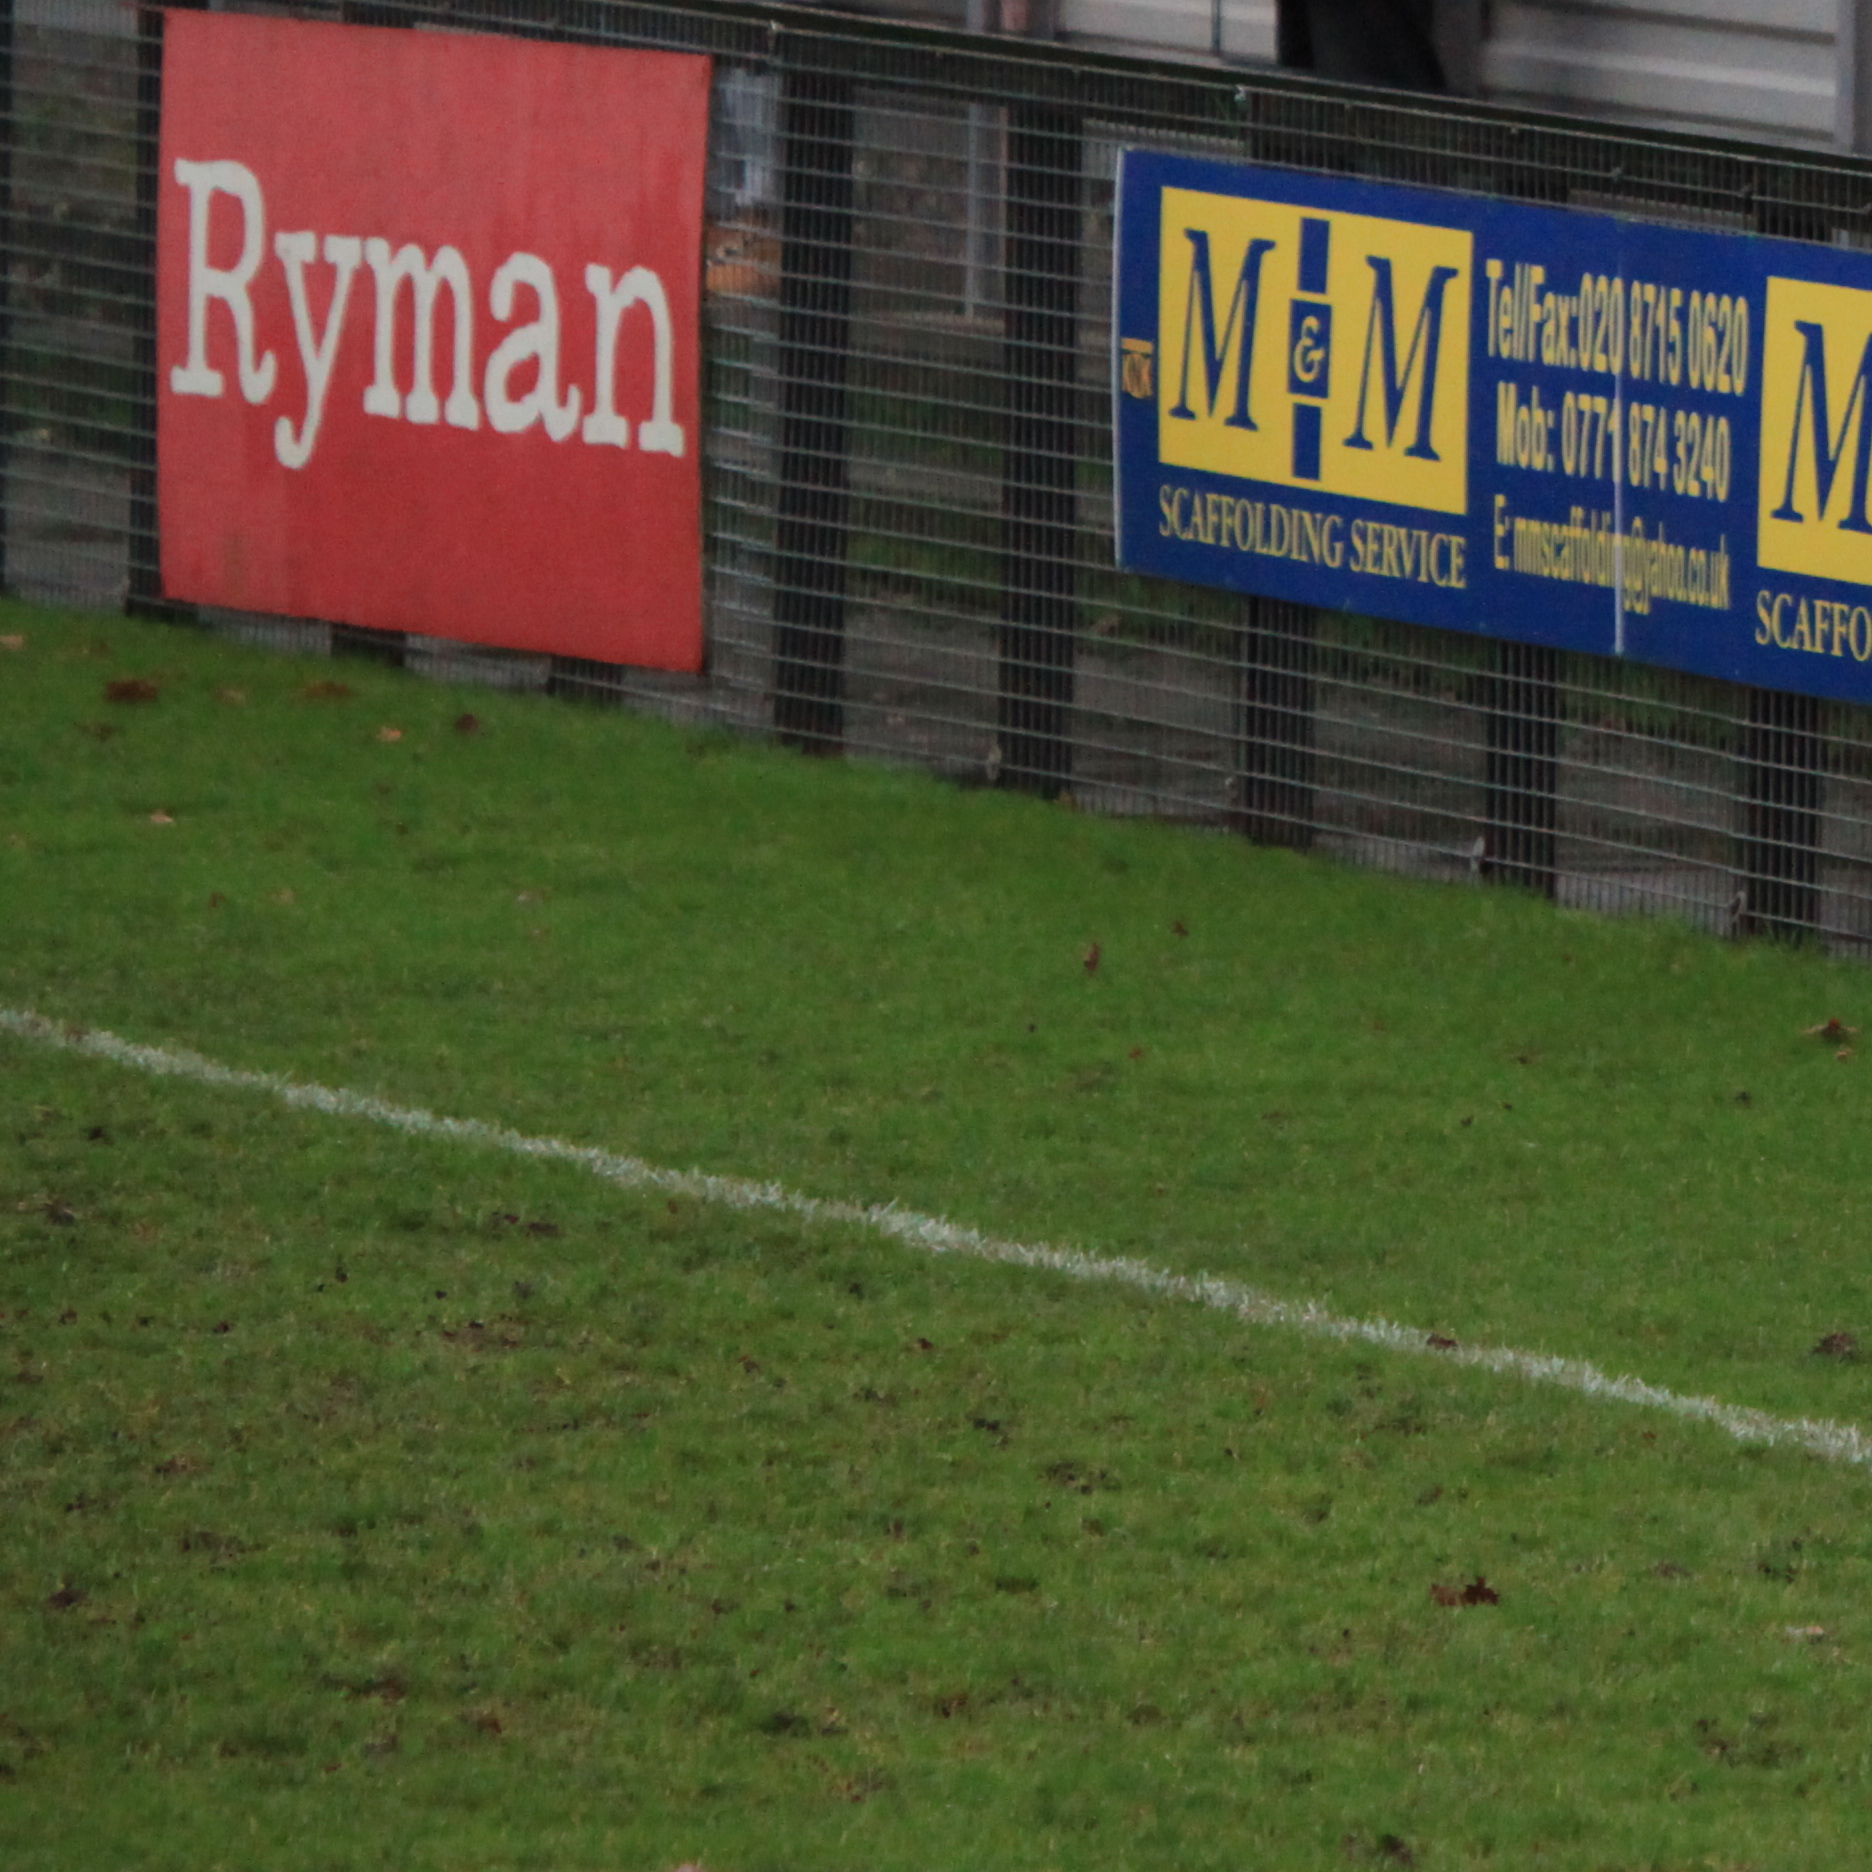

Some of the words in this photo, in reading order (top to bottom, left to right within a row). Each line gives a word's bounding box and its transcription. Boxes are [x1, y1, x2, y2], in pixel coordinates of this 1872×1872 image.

[170, 157, 686, 469] Ryman
[1629, 280, 1683, 386] 8715
[1688, 290, 1749, 397] 0620
[1497, 380, 1554, 473] Mob:
[1562, 390, 1623, 483] 0771
[1629, 400, 1668, 491] 874
[1674, 409, 1731, 503] 3240
[1159, 483, 1344, 568] SCAFFOLDING
[1351, 518, 1467, 589] SERVICE
